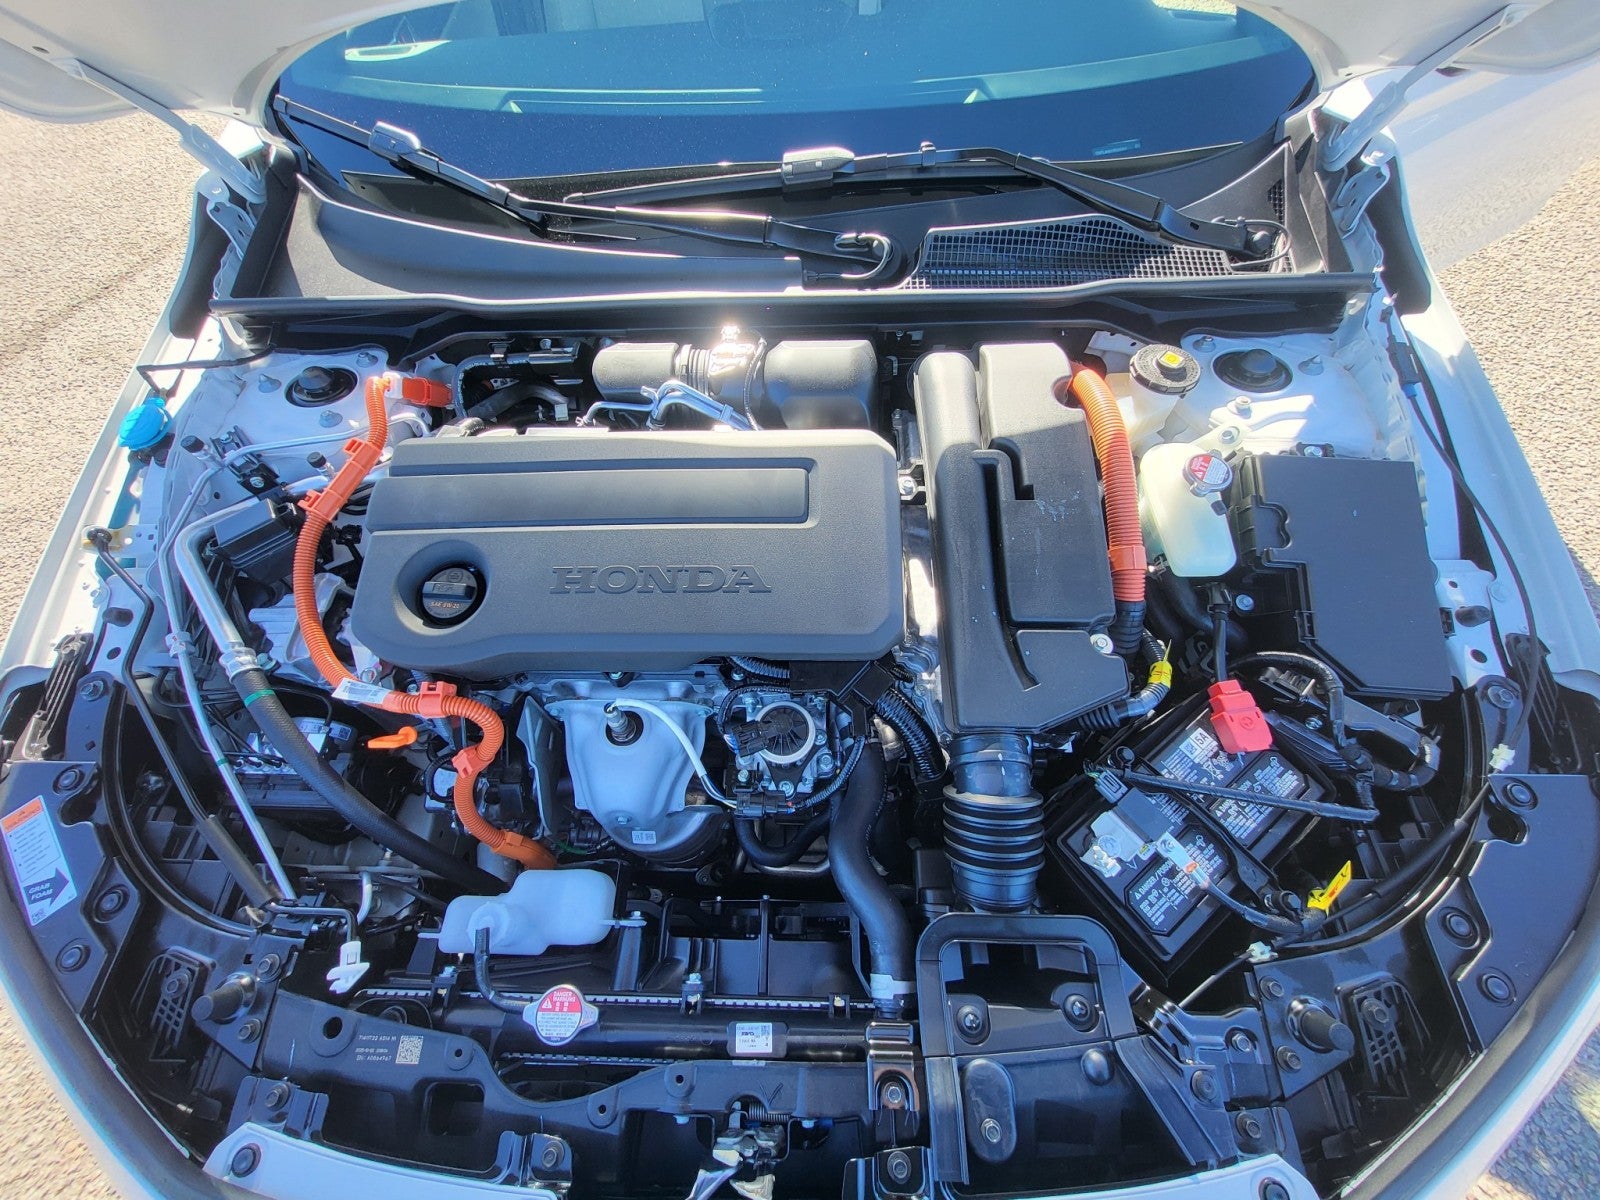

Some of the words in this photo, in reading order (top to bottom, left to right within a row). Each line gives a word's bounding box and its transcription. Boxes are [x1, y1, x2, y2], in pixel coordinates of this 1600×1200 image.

[549, 564, 772, 595] HONDA
[1194, 731, 1209, 746] 5A
[28, 882, 51, 894] GRAB
[31, 888, 54, 901] FOAM
